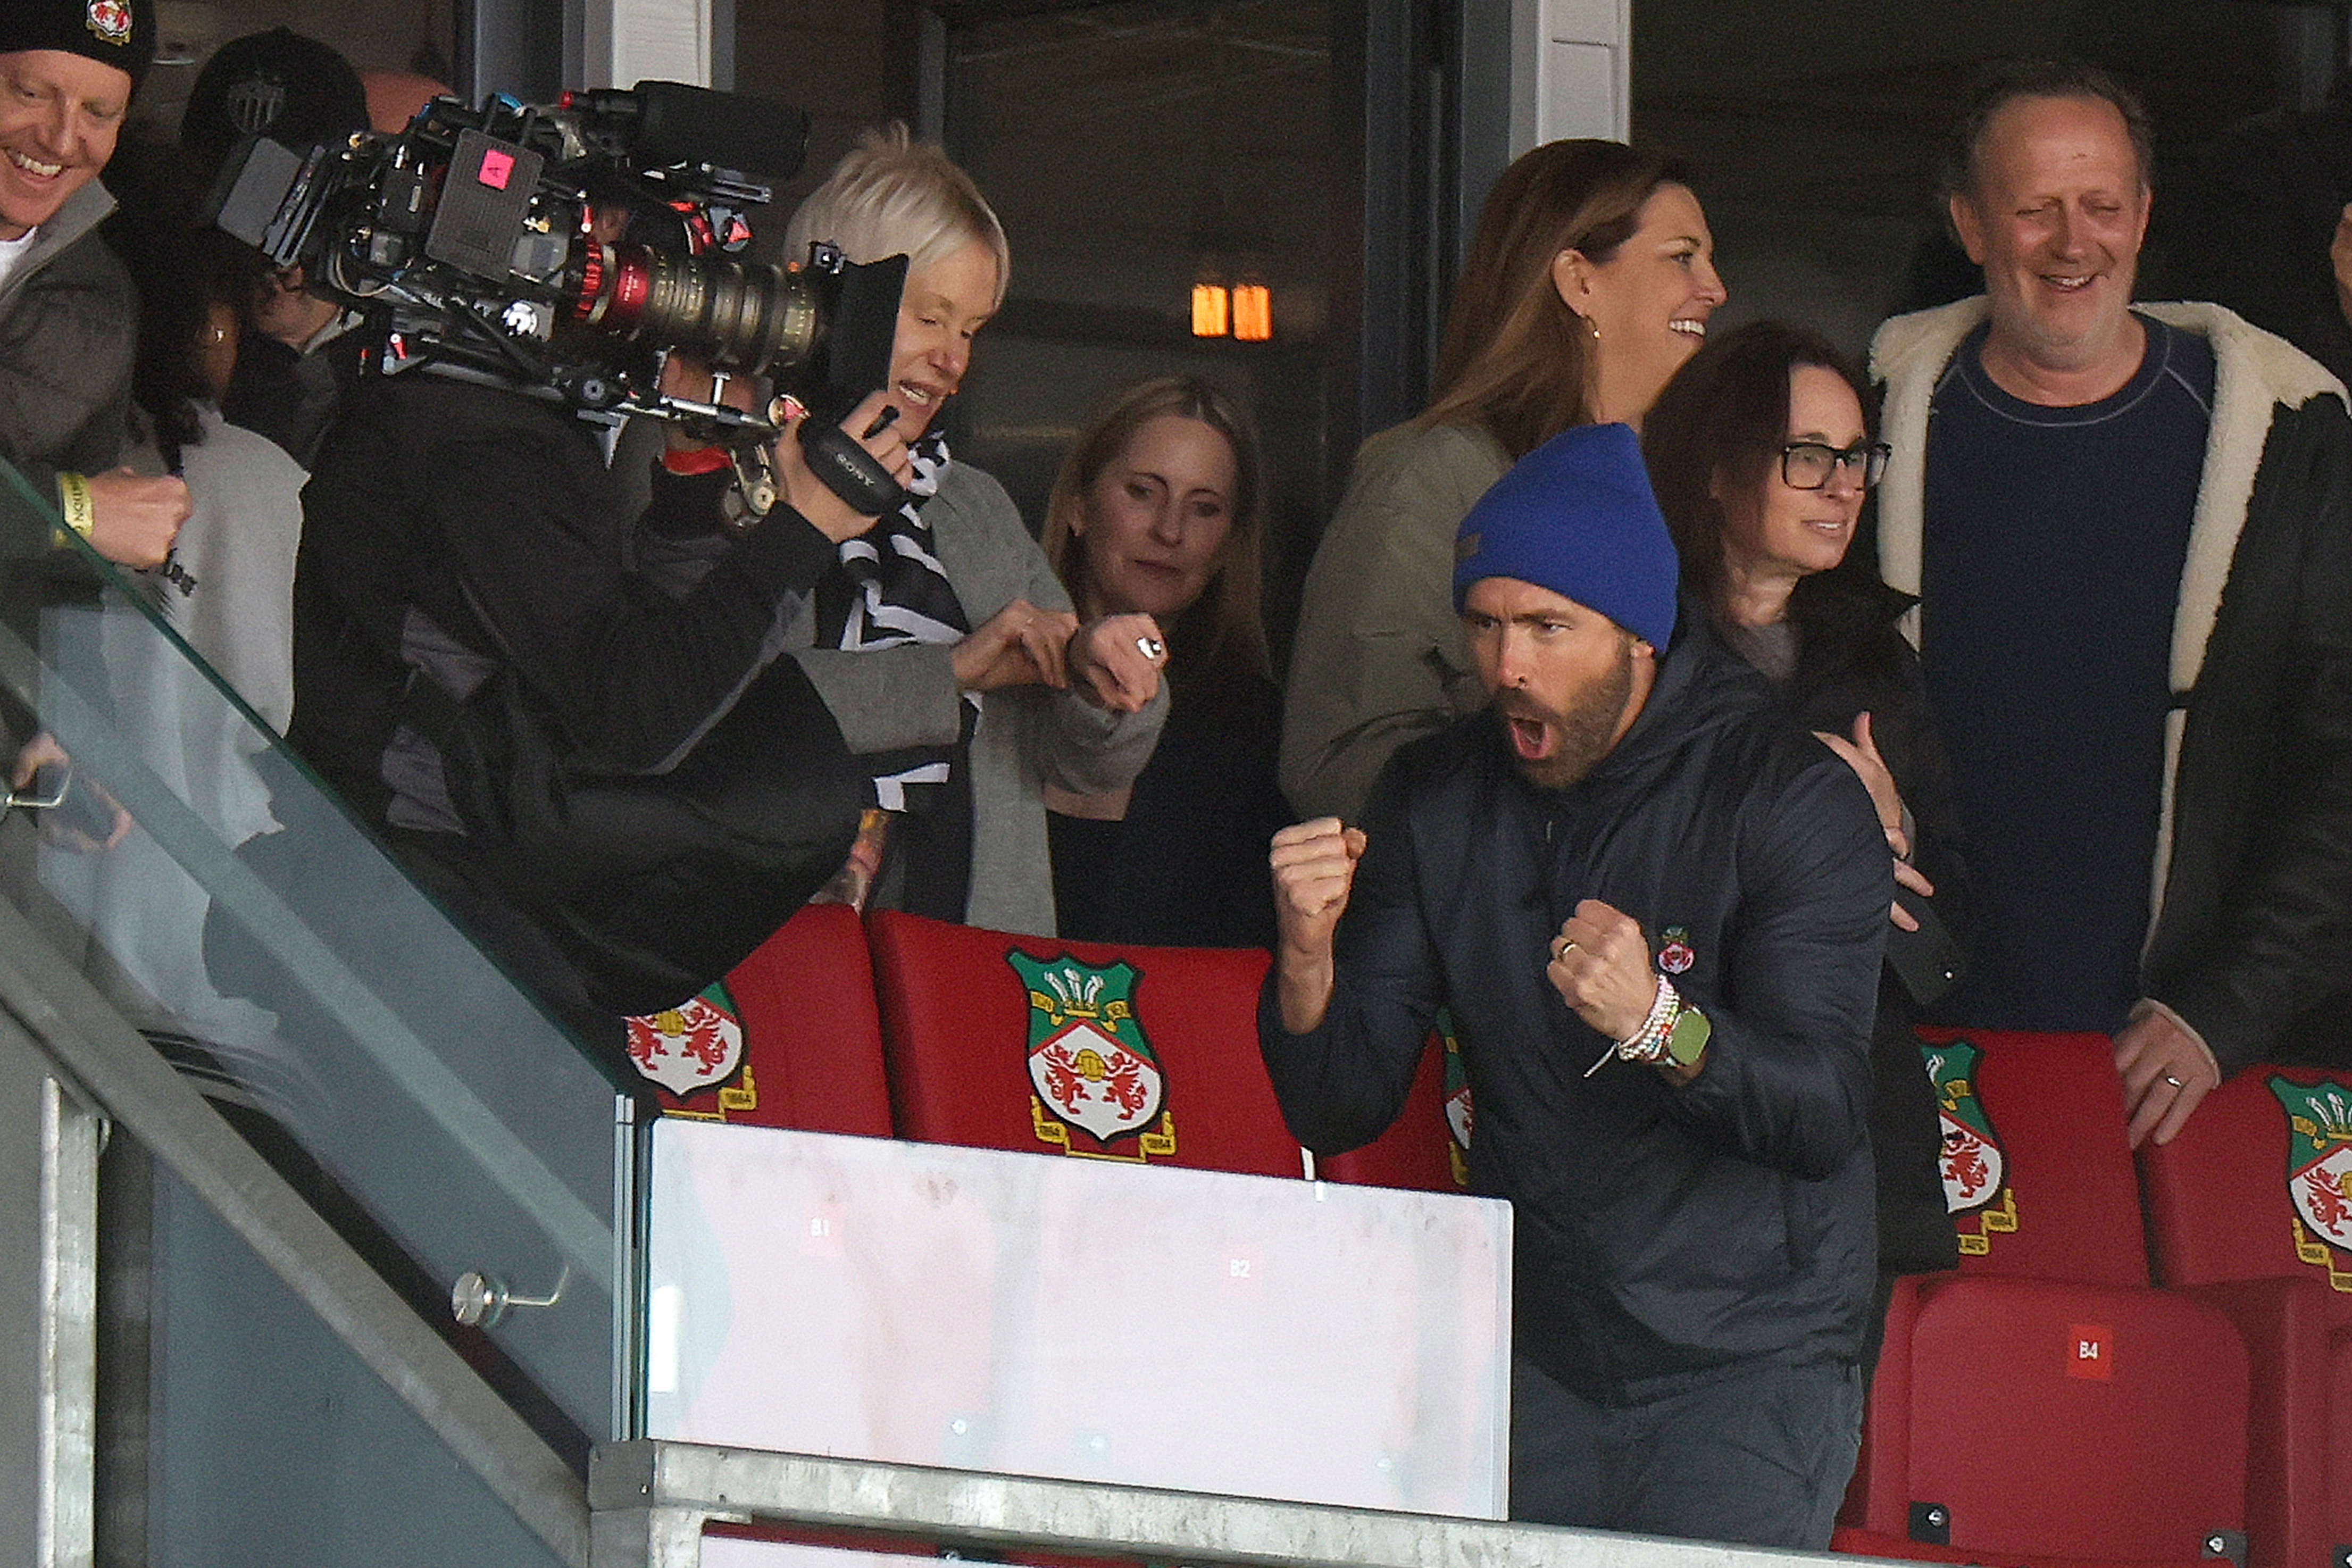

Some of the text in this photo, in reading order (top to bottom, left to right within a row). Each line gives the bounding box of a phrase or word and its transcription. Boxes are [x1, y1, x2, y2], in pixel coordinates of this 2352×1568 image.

[834, 453, 875, 487] SONY
[811, 1217, 830, 1237] B1
[1229, 1258, 1250, 1278] B2
[2079, 1339, 2098, 1360] B4
